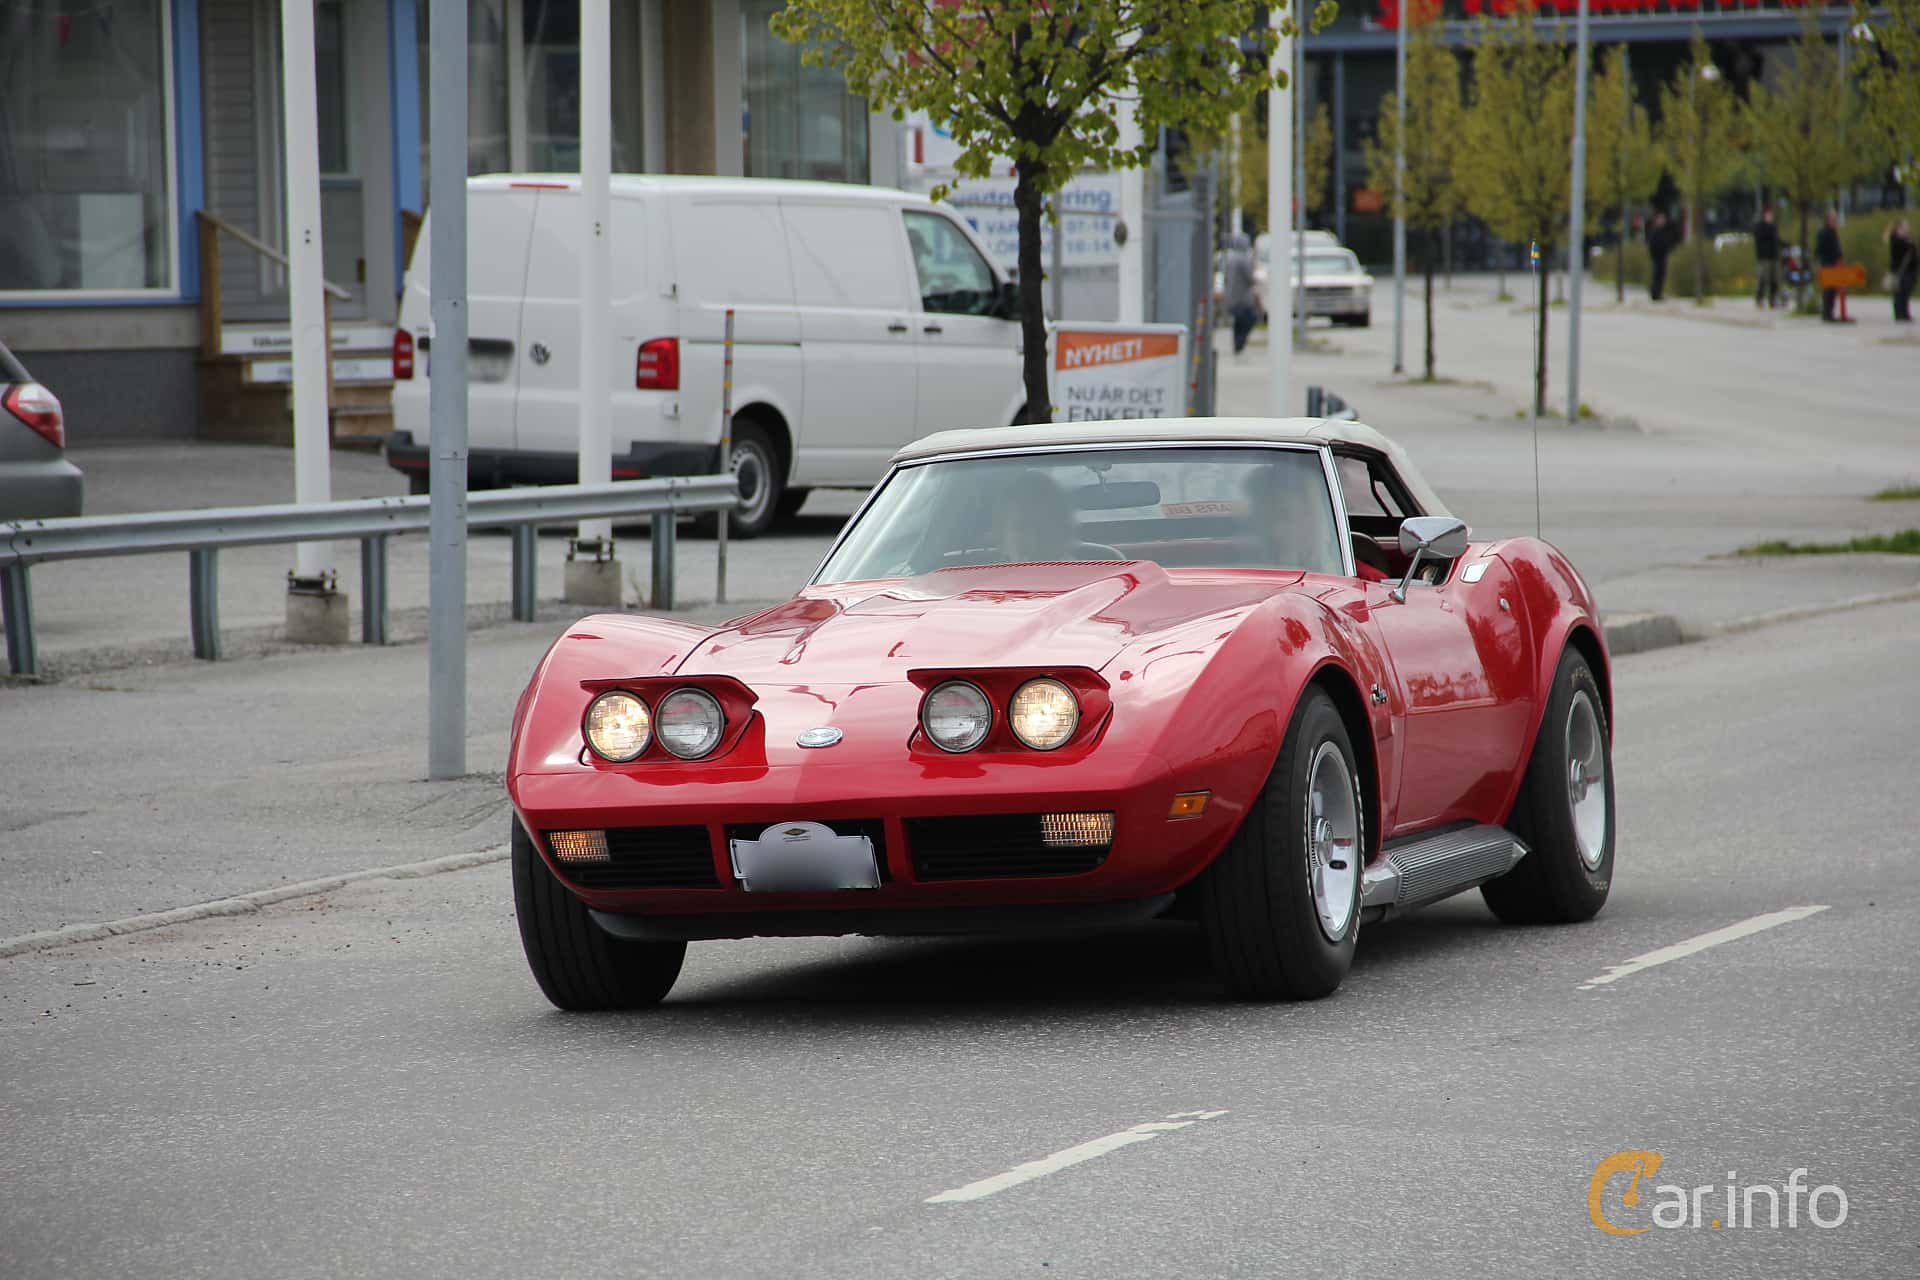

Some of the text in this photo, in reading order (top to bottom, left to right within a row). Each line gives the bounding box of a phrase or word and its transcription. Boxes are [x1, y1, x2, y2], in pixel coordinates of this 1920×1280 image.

[1065, 339, 1143, 366] NYHET!
[1067, 383, 1165, 404] NU ÄR DET
